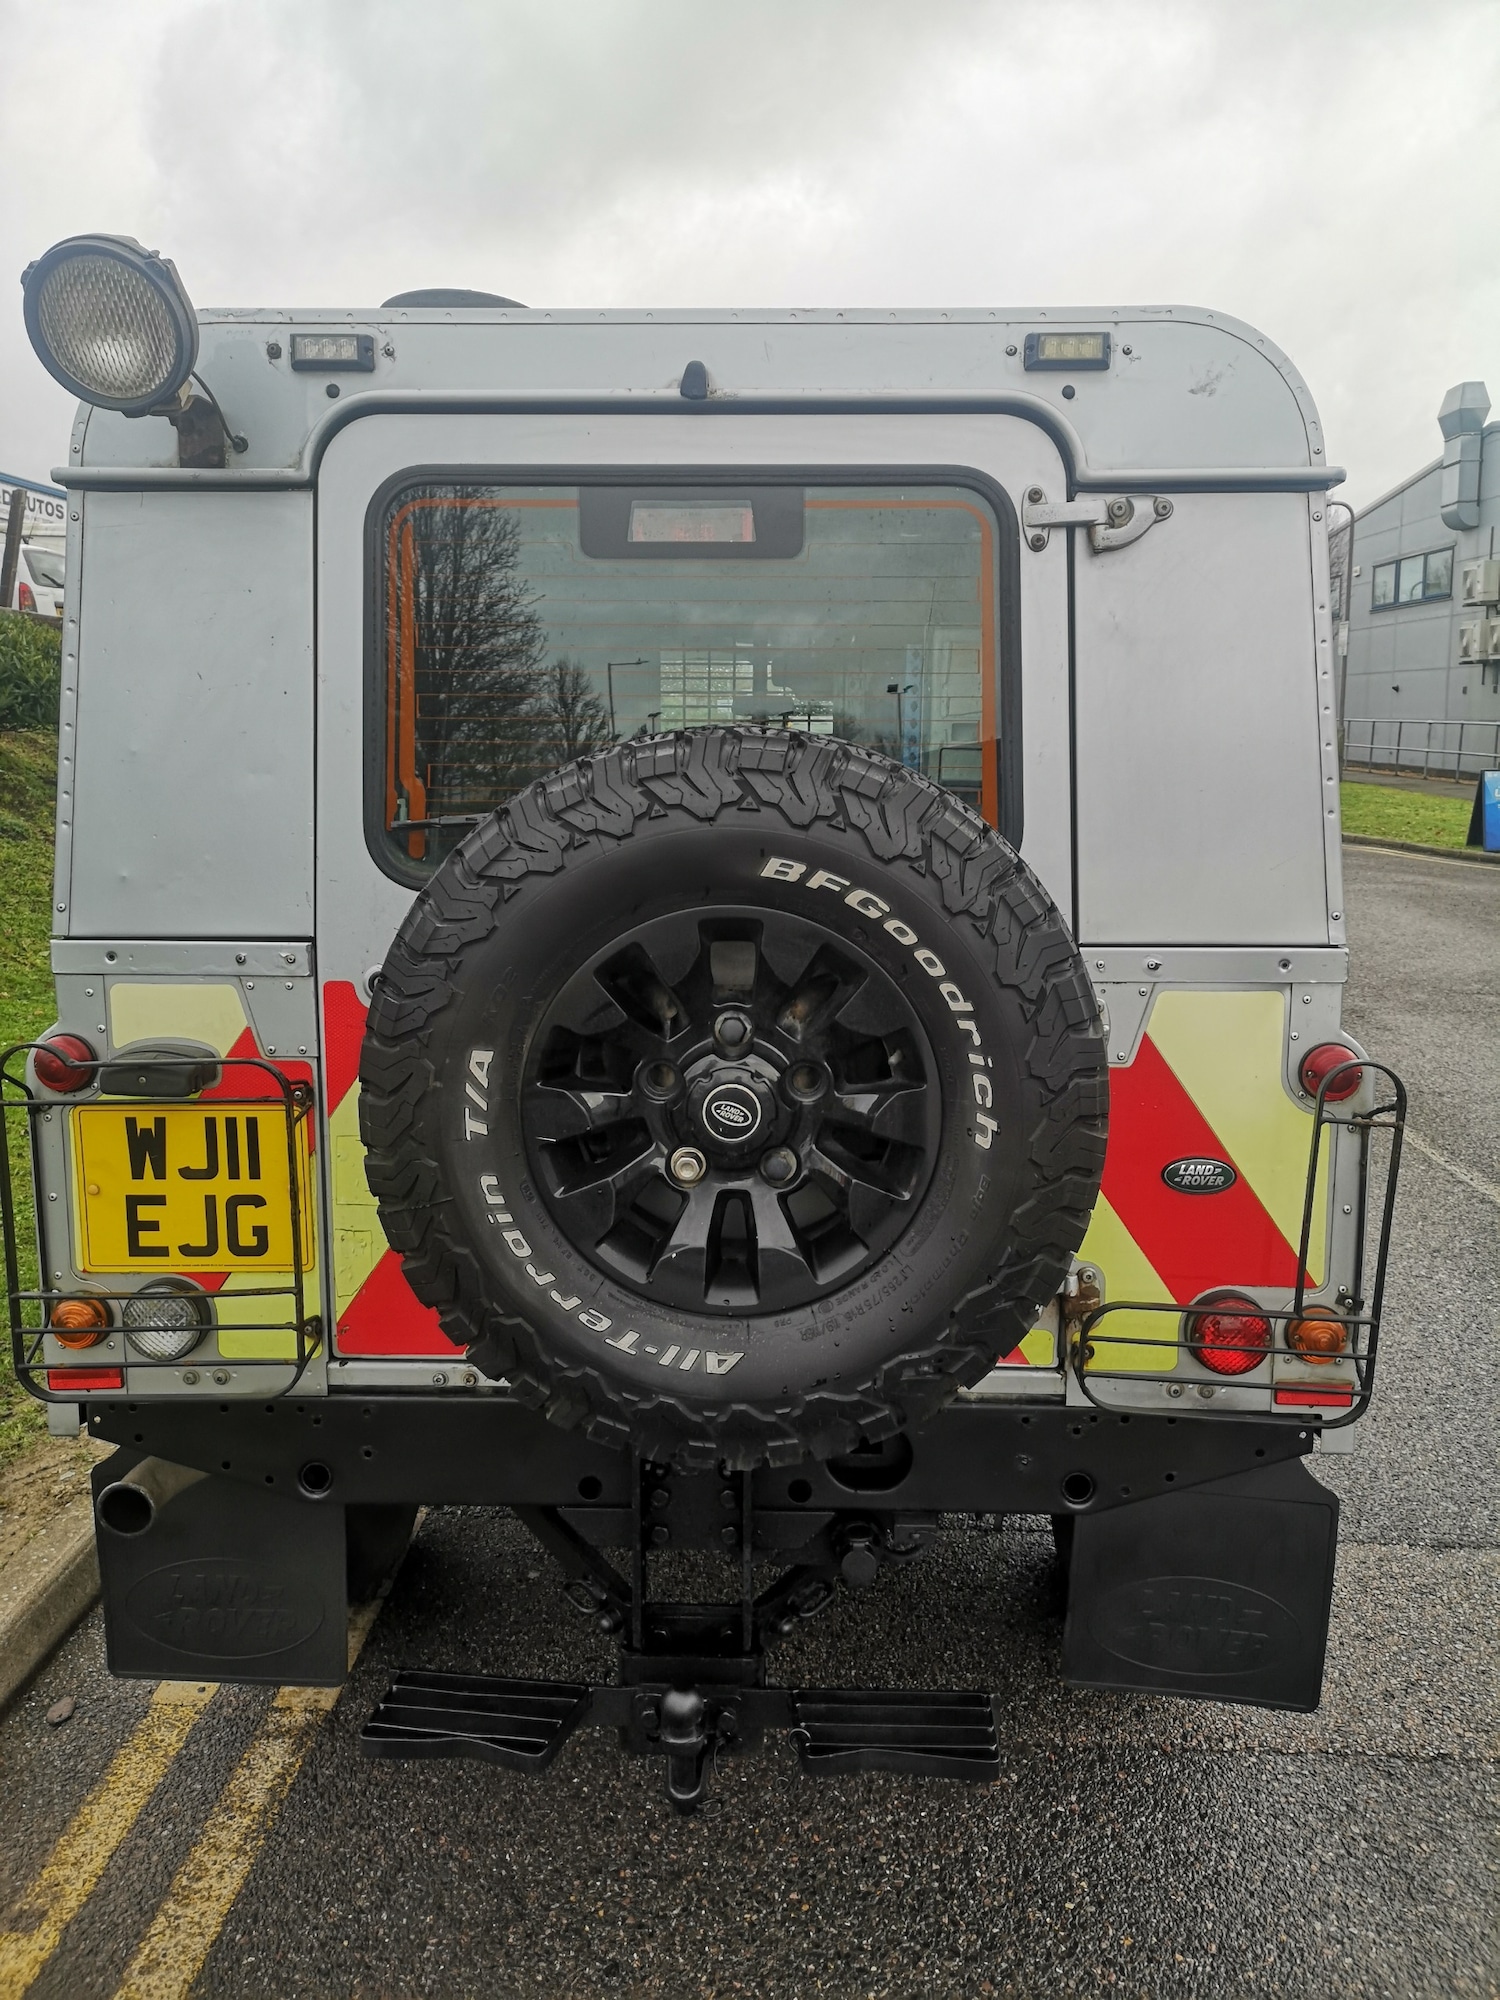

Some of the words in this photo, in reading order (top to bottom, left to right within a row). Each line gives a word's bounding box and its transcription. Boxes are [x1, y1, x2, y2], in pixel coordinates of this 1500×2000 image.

[25, 496, 64, 520] UTOS
[759, 856, 996, 1151] BFGoodrich
[464, 1049, 495, 1142] T/A
[719, 1110, 744, 1123] ROVER
[720, 1104, 742, 1116] LAND
[124, 1117, 261, 1180] WJ11
[1178, 1164, 1214, 1176] LAND
[1181, 1175, 1225, 1186] ROVER
[125, 1194, 269, 1258] EJG
[479, 1174, 746, 1375] All-Terrain
